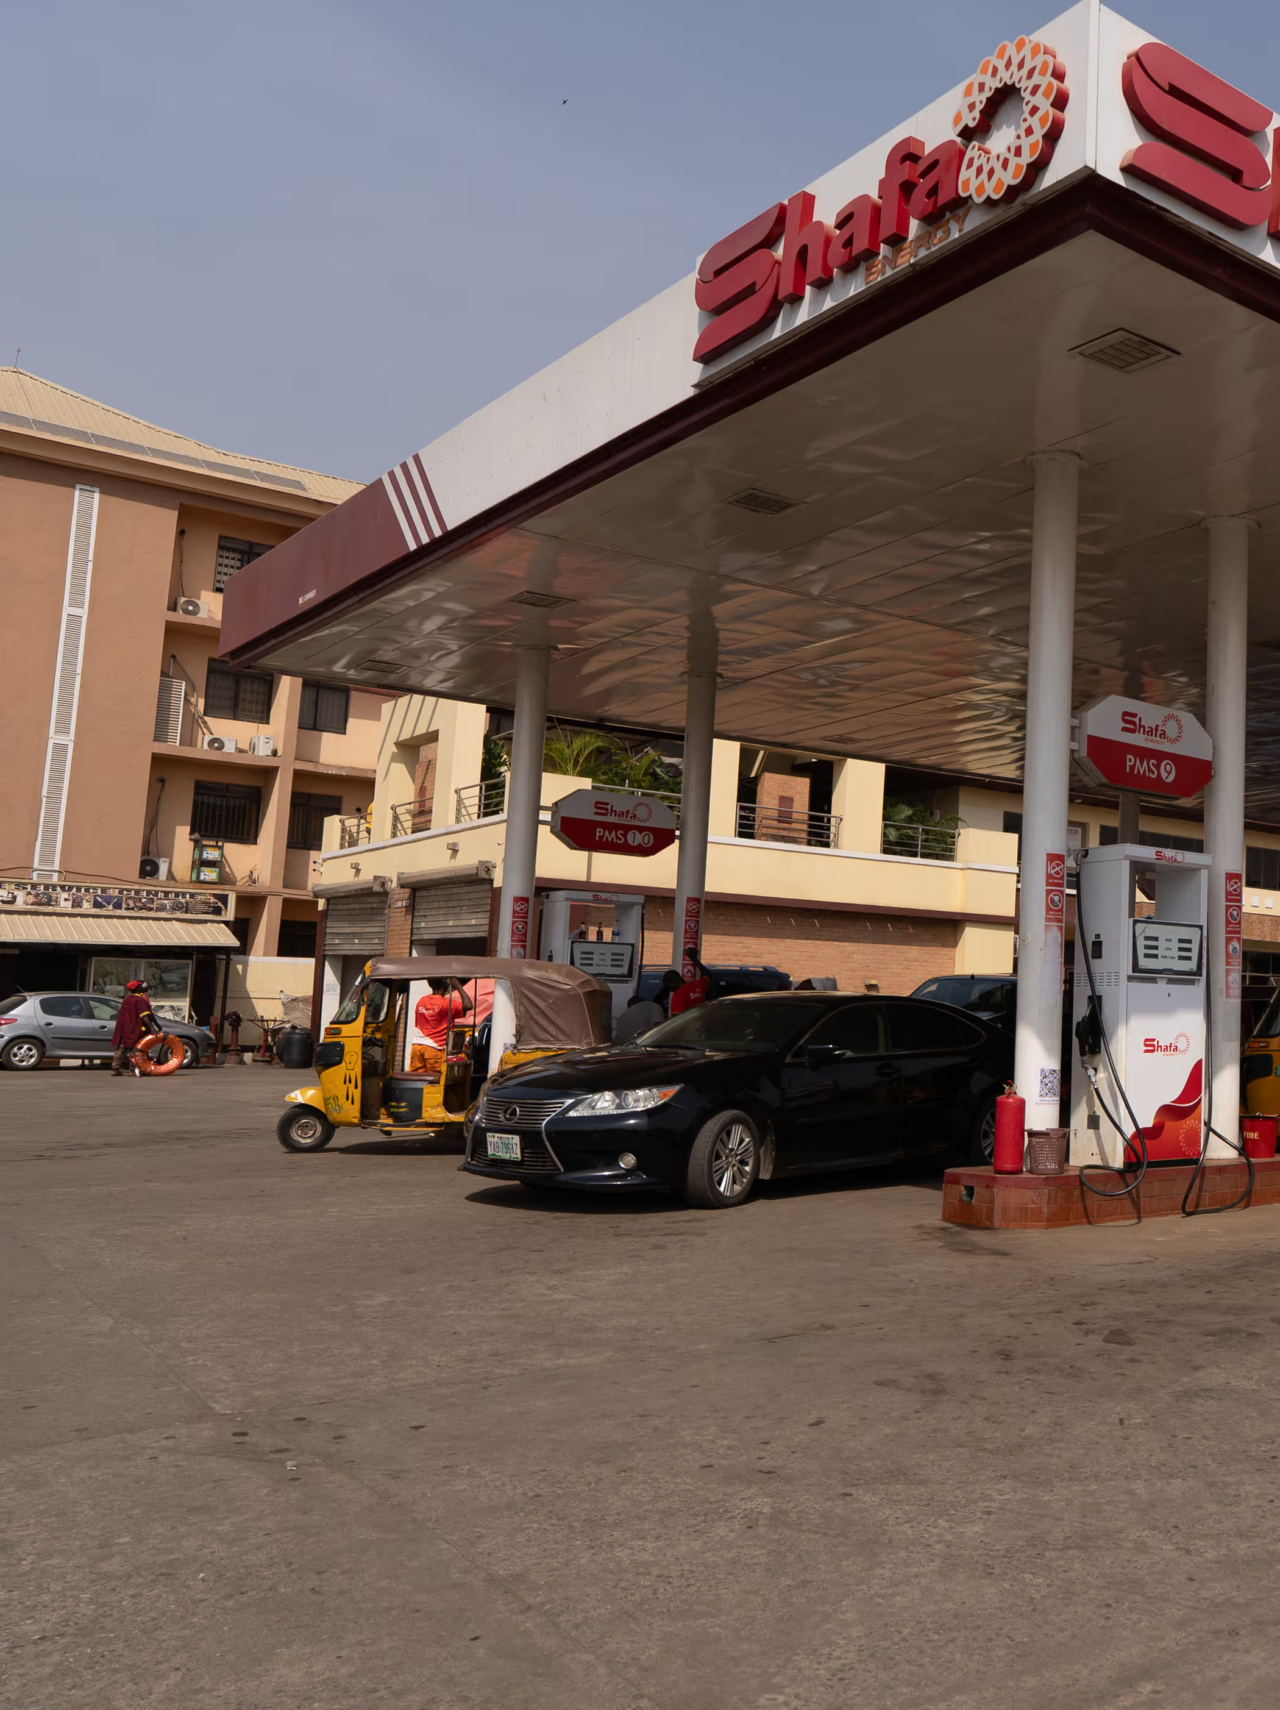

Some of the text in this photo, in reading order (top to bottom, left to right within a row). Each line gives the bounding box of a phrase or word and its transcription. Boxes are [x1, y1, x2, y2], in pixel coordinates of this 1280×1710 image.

[693, 136, 969, 365] Shafa
[865, 205, 971, 285] ENERGY
[1121, 710, 1166, 740] Shafa
[1126, 755, 1174, 781] PMS 9
[593, 800, 637, 820] Shafa
[595, 828, 625, 843] PMS
[1143, 1038, 1178, 1053] Shafa
[1243, 1131, 1260, 1140] FIRE
